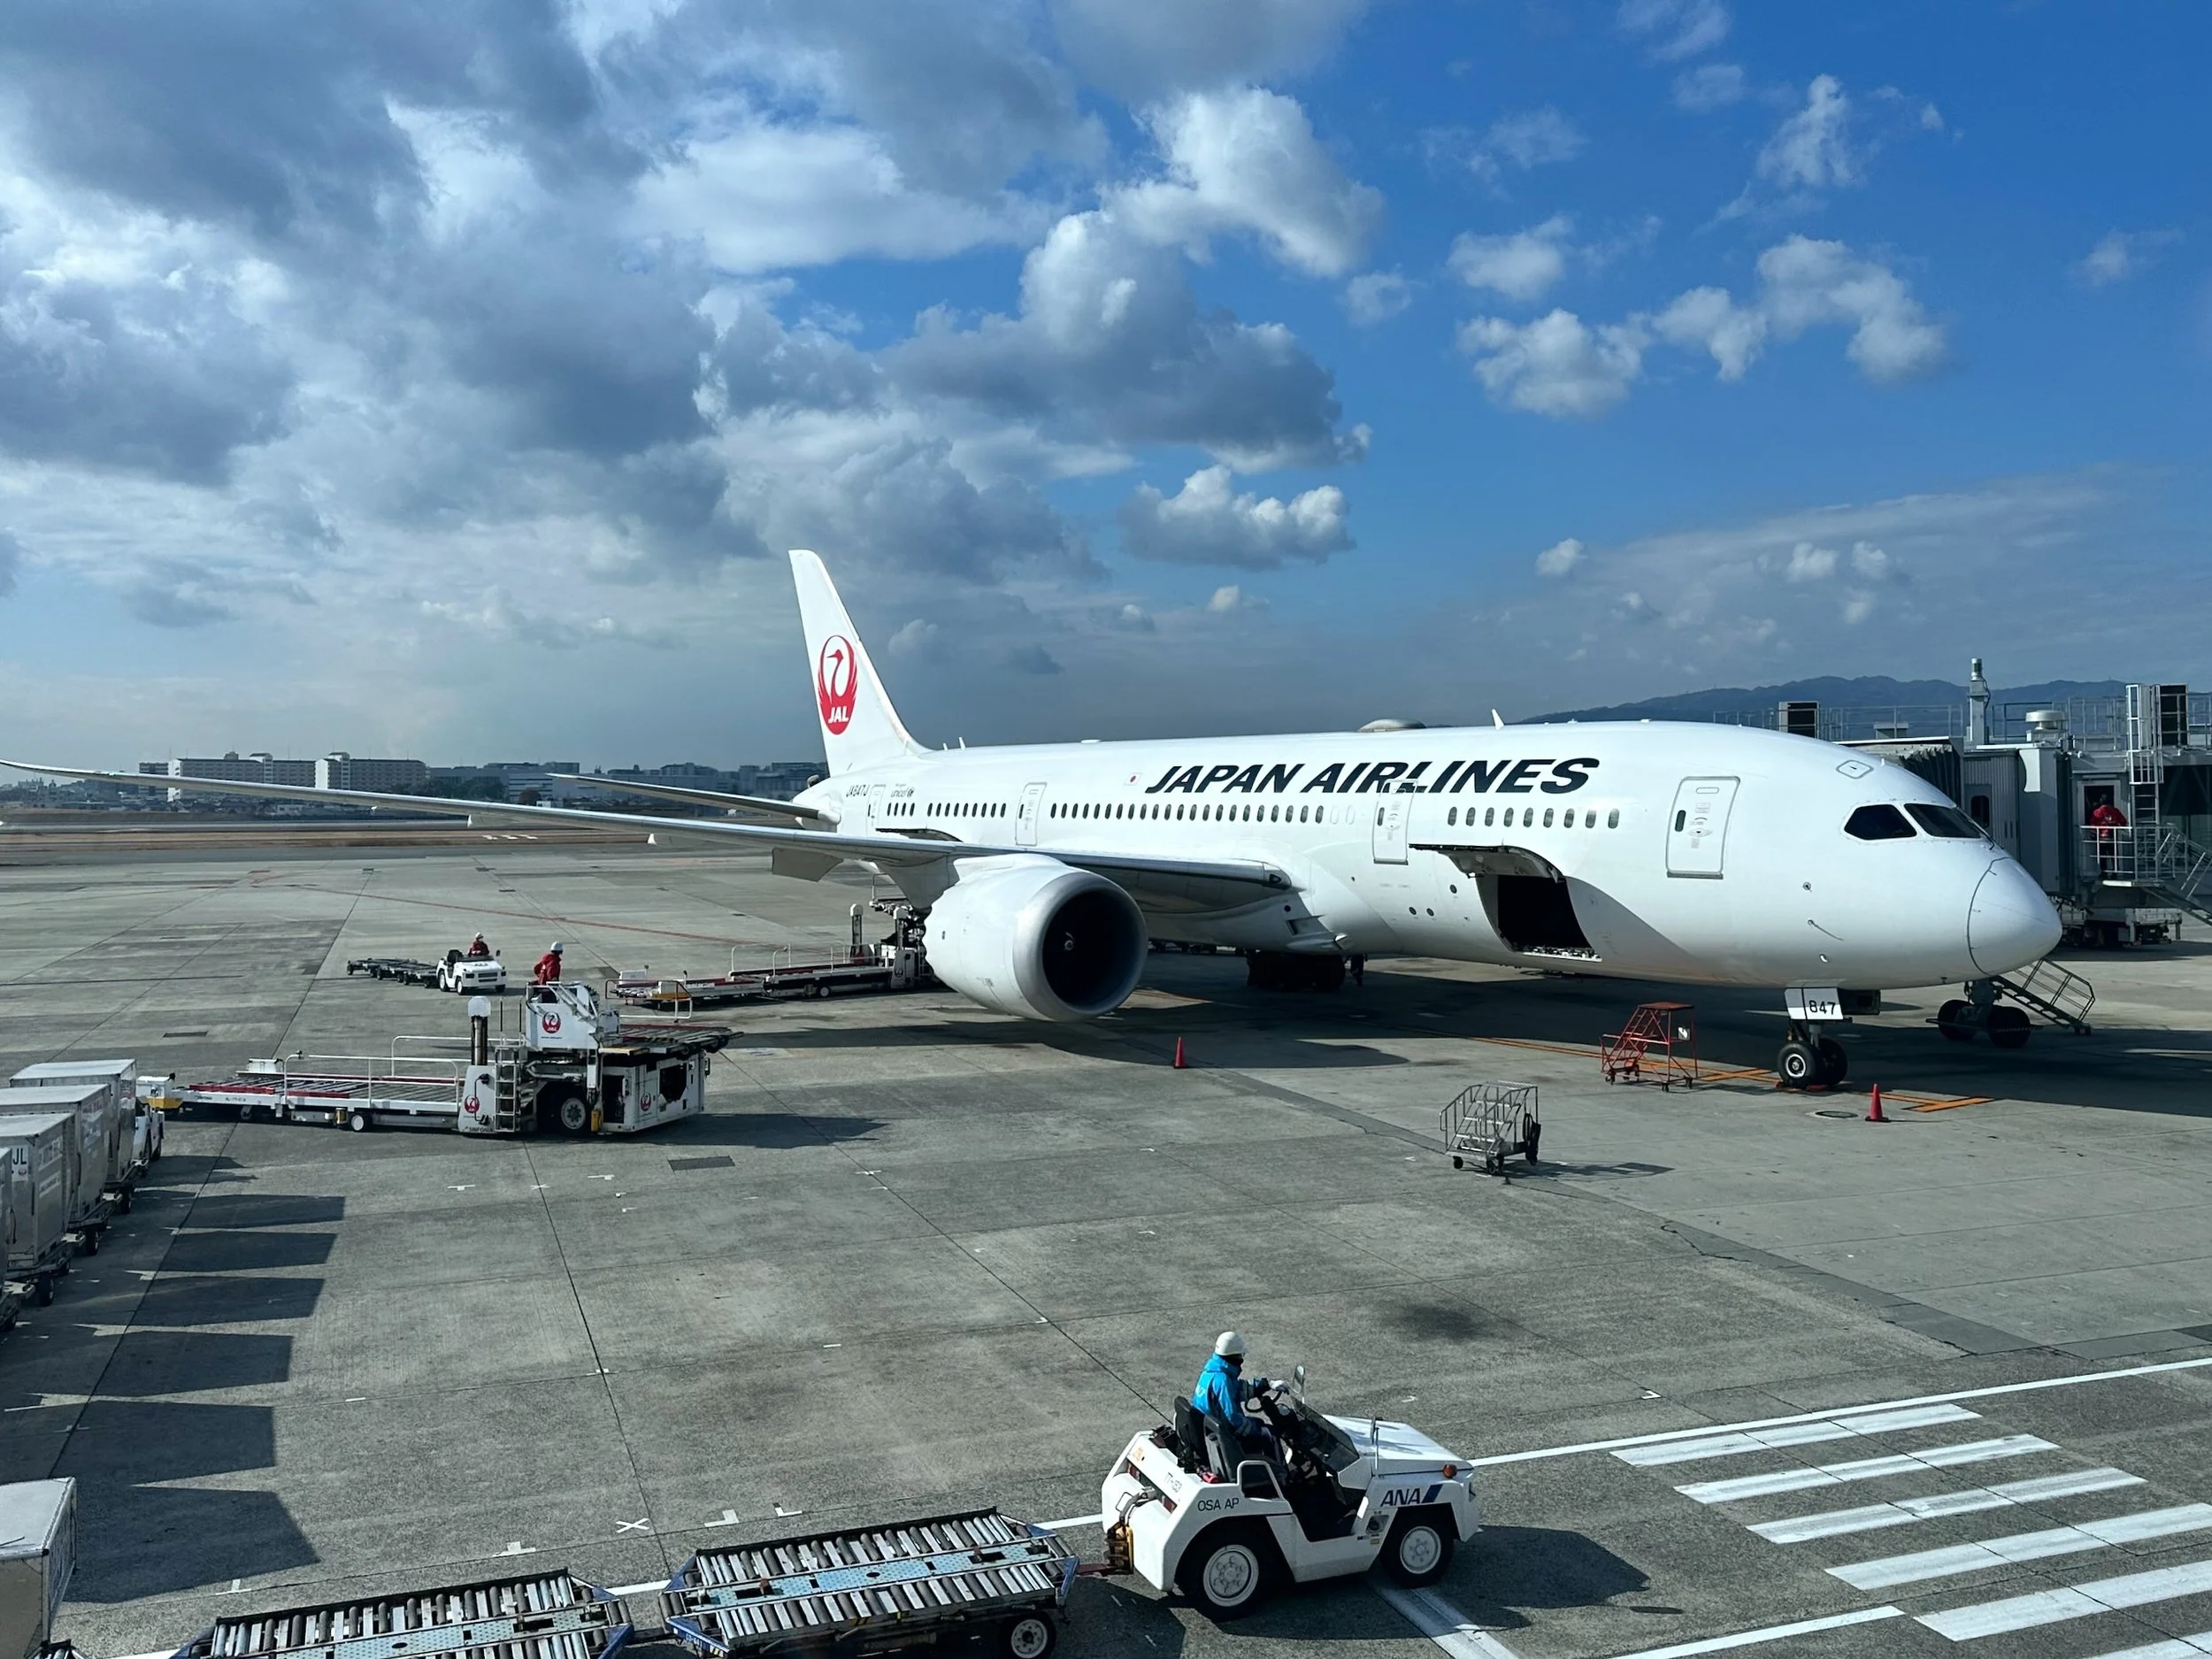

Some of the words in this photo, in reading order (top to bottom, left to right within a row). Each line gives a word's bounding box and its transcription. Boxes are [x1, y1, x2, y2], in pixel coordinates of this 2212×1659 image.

[827, 705, 849, 724] JAL
[1145, 764, 1305, 794] JAPAN
[1299, 757, 1600, 795] AIRLINES
[1809, 999, 1836, 1015] 847
[12, 1148, 27, 1165] JL
[1197, 1499, 1222, 1511] OSA
[1225, 1497, 1240, 1509] AP
[1380, 1487, 1421, 1508] ANA
